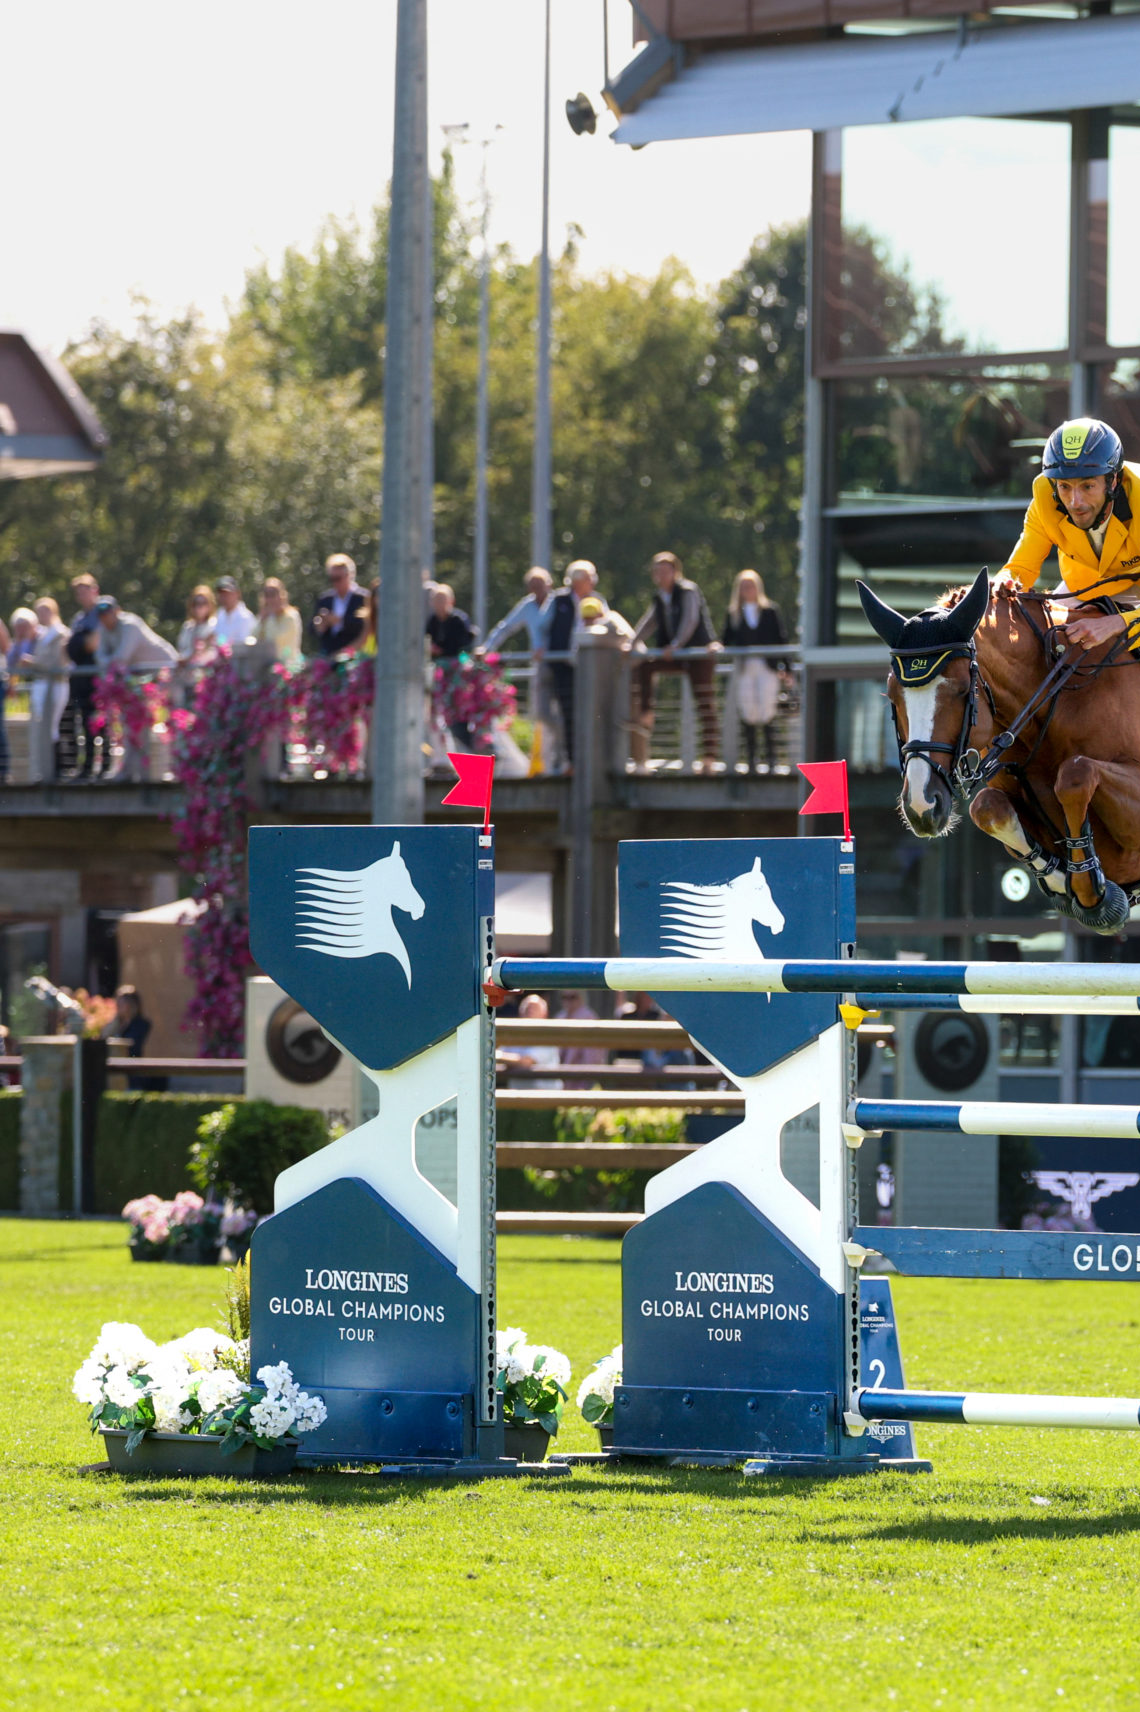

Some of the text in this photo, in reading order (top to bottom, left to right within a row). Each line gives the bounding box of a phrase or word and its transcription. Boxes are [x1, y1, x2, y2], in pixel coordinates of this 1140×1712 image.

[1065, 436, 1081, 445] QH
[911, 658, 928, 668] QH
[306, 1268, 408, 1294] LONGINES
[675, 1271, 774, 1294] LONGINES
[269, 1296, 445, 1323] GLOBAL CHAMPIONS
[641, 1299, 809, 1322] GLOBAL CHAMPIONS
[338, 1327, 375, 1342] TOUR
[707, 1328, 742, 1342] TOUR
[869, 1359, 886, 1388] 2
